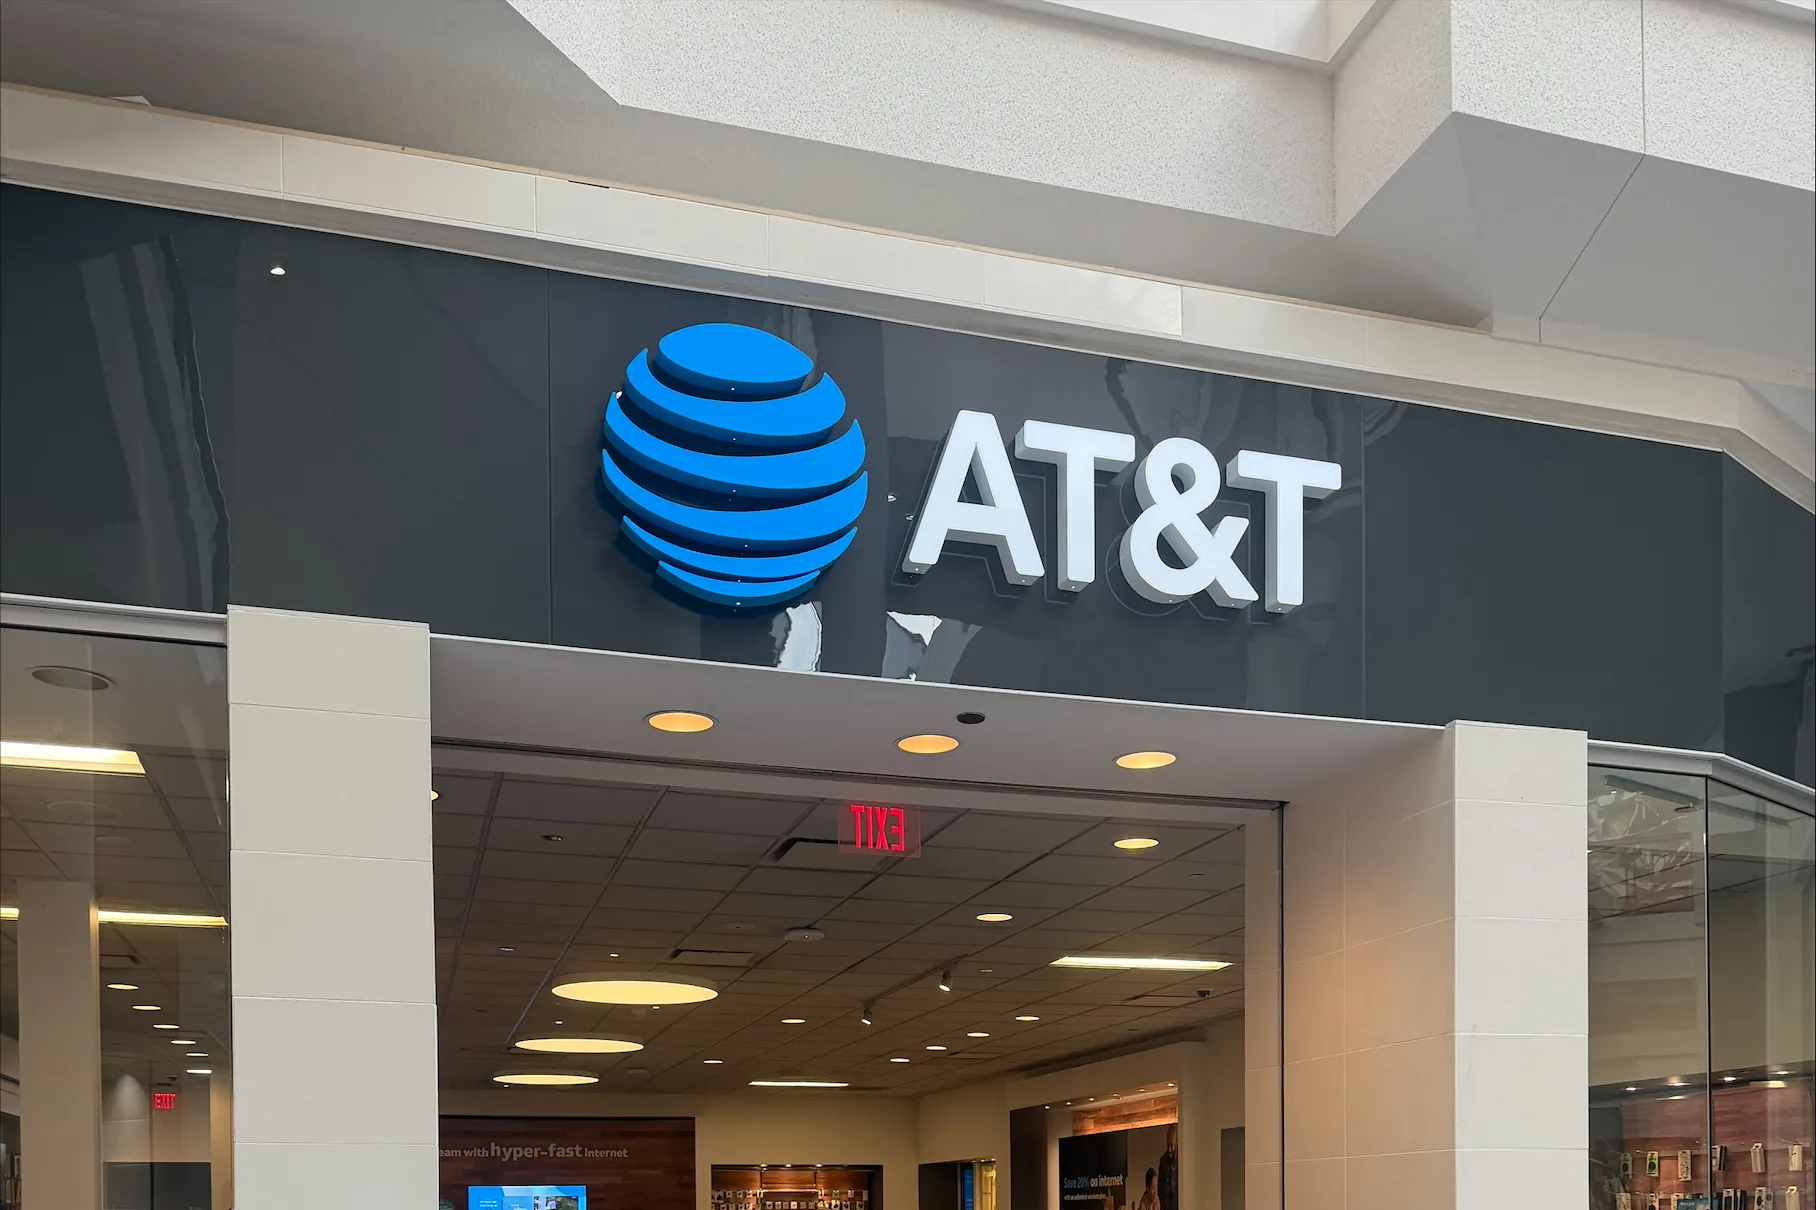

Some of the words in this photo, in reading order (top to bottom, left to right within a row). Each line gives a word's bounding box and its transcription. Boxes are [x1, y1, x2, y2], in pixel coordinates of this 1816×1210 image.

[902, 409, 1342, 614] AT&T
[153, 1093, 176, 1110] EXIT
[438, 1149, 462, 1158] eam
[463, 1147, 490, 1158] with
[490, 1142, 582, 1161] hyper-fast
[1090, 1178, 1098, 1187] on
[1099, 1174, 1123, 1186] internet
